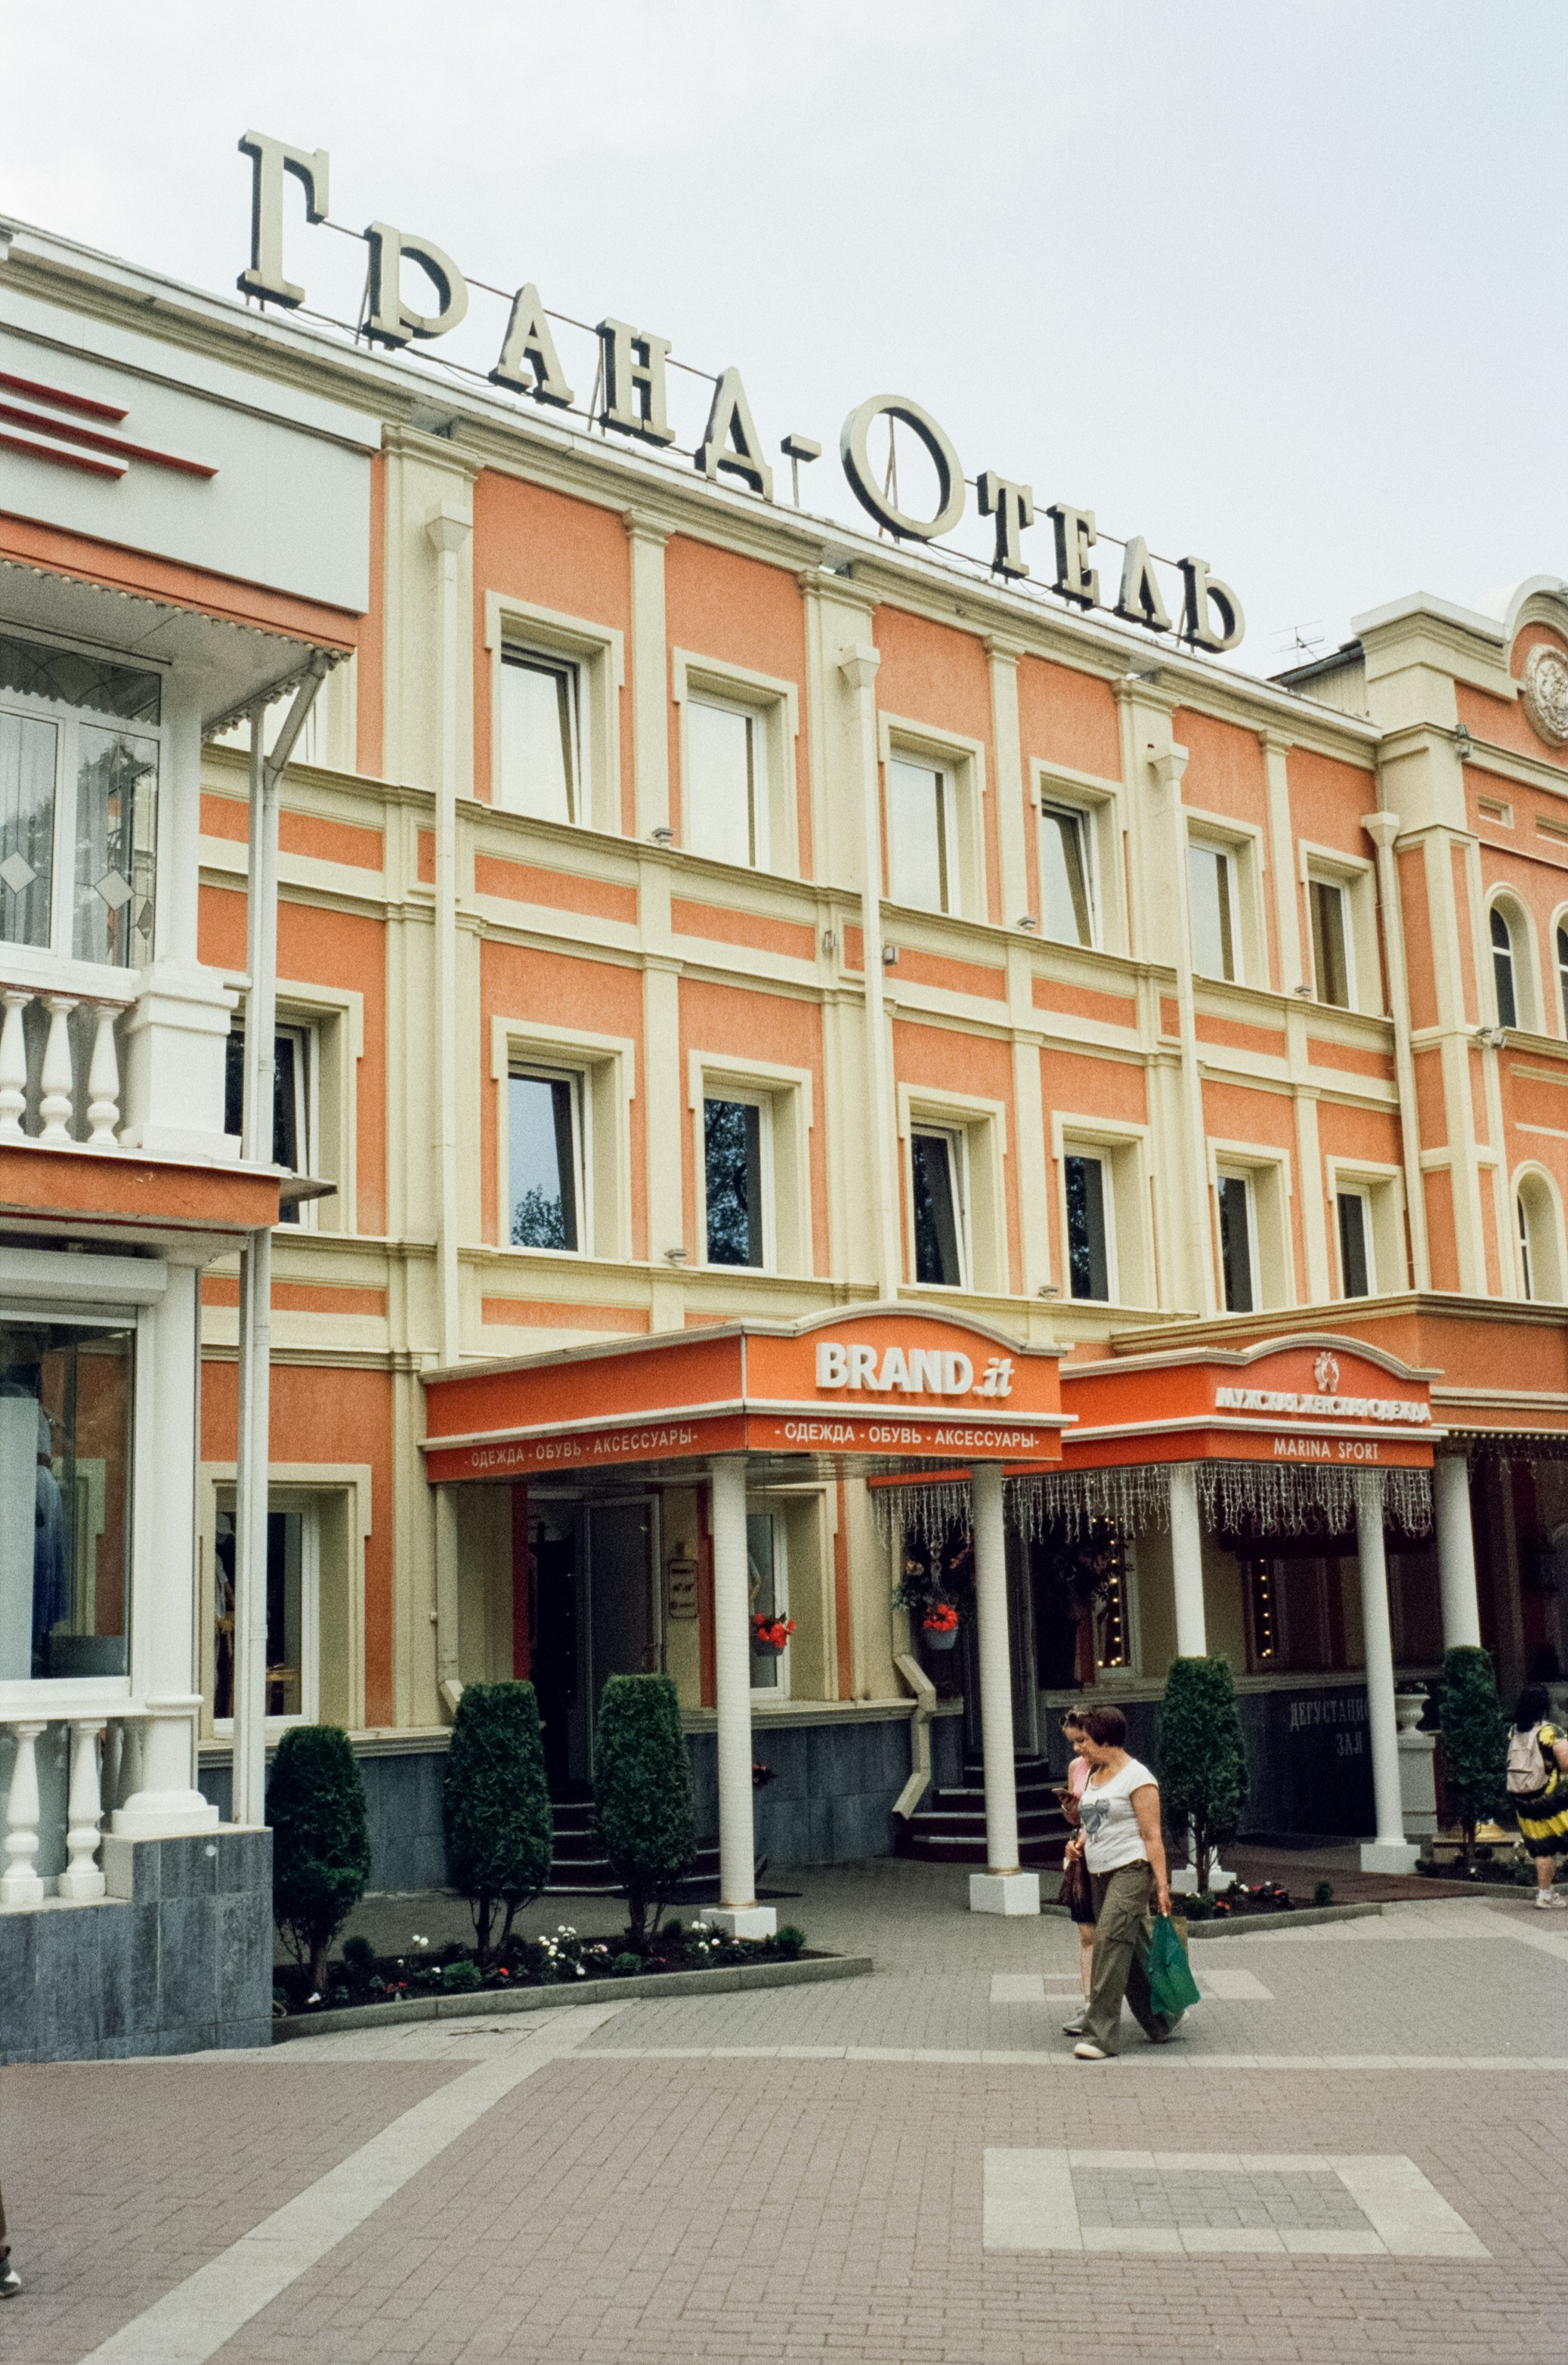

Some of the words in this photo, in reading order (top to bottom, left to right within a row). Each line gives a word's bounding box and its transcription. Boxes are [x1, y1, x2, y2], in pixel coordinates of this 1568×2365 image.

[784, 1422, 855, 1444] ОДЕЖДА
[869, 1426, 922, 1444] ОБУВЬ
[472, 1447, 524, 1468] ОДЕЖДА
[536, 1439, 582, 1460] ОБУВЬ
[1274, 1438, 1330, 1458] MARINA
[1338, 1441, 1378, 1460] SPORT
[1336, 1731, 1362, 1757] ЗАЛ
